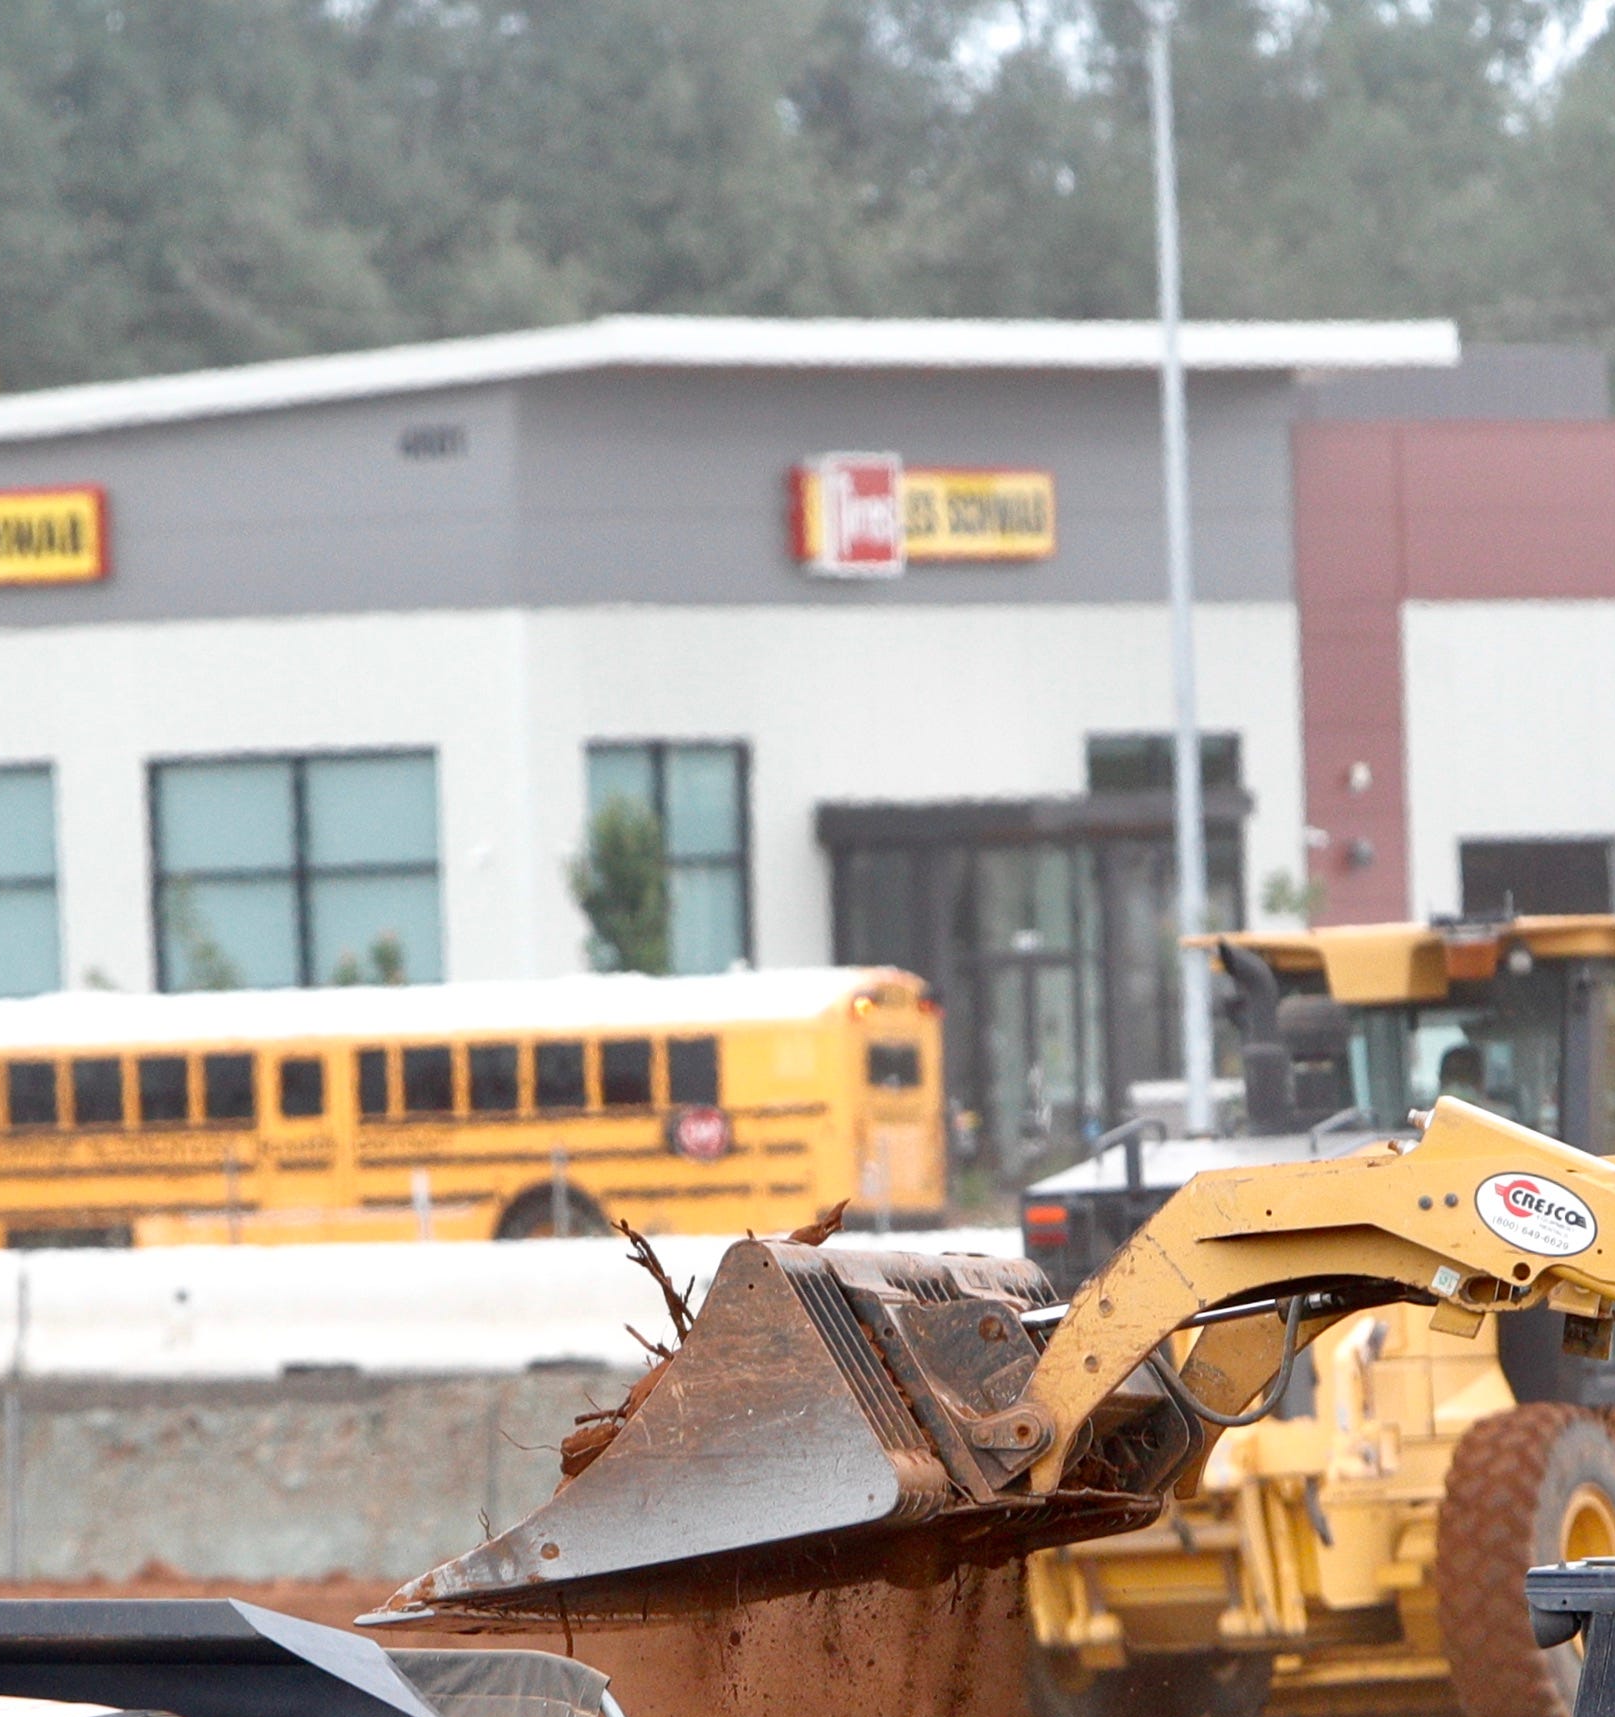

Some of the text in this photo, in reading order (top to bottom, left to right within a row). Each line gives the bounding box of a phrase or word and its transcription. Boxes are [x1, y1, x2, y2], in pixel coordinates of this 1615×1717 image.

[1512, 1190, 1584, 1228] CRESCO
[1492, 1215, 1570, 1251] (800) 649-6629
